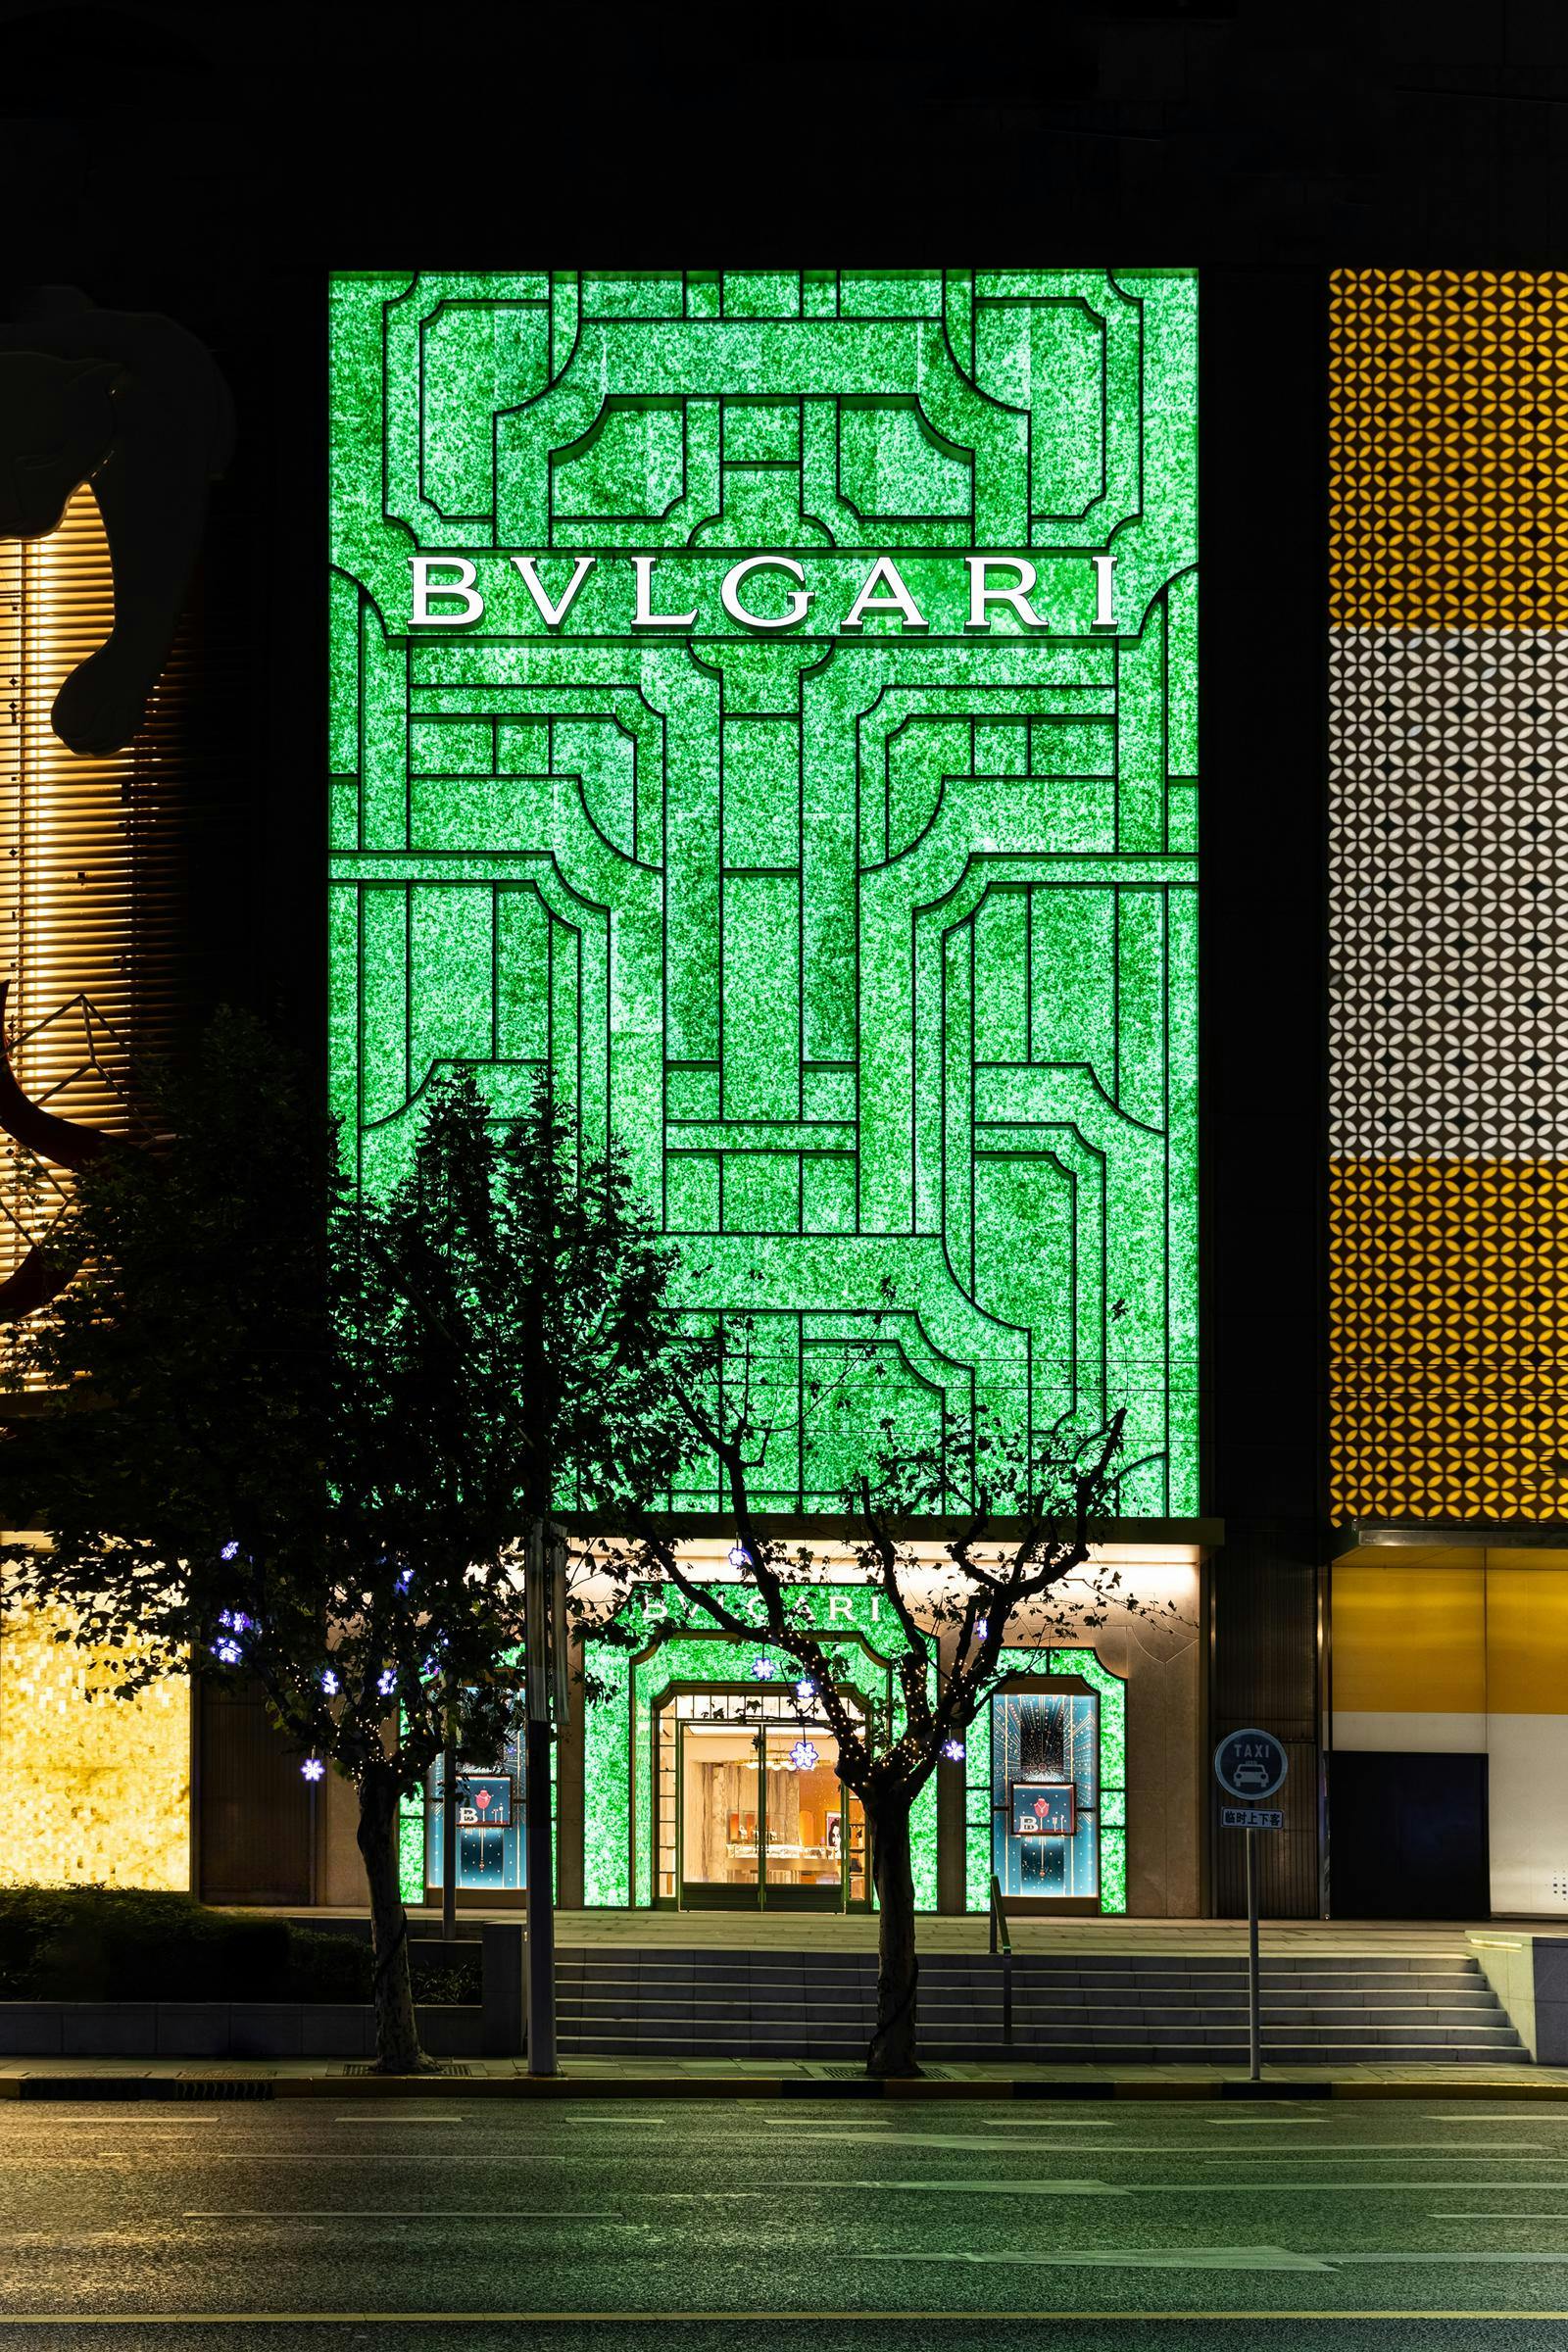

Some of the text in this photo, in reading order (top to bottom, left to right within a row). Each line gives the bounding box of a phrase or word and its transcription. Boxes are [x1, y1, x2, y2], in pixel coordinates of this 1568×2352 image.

[408, 555, 1117, 627] BVLGARI
[1234, 1743, 1269, 1758] TAXI
[1225, 1810, 1280, 1826] 临时上下客
